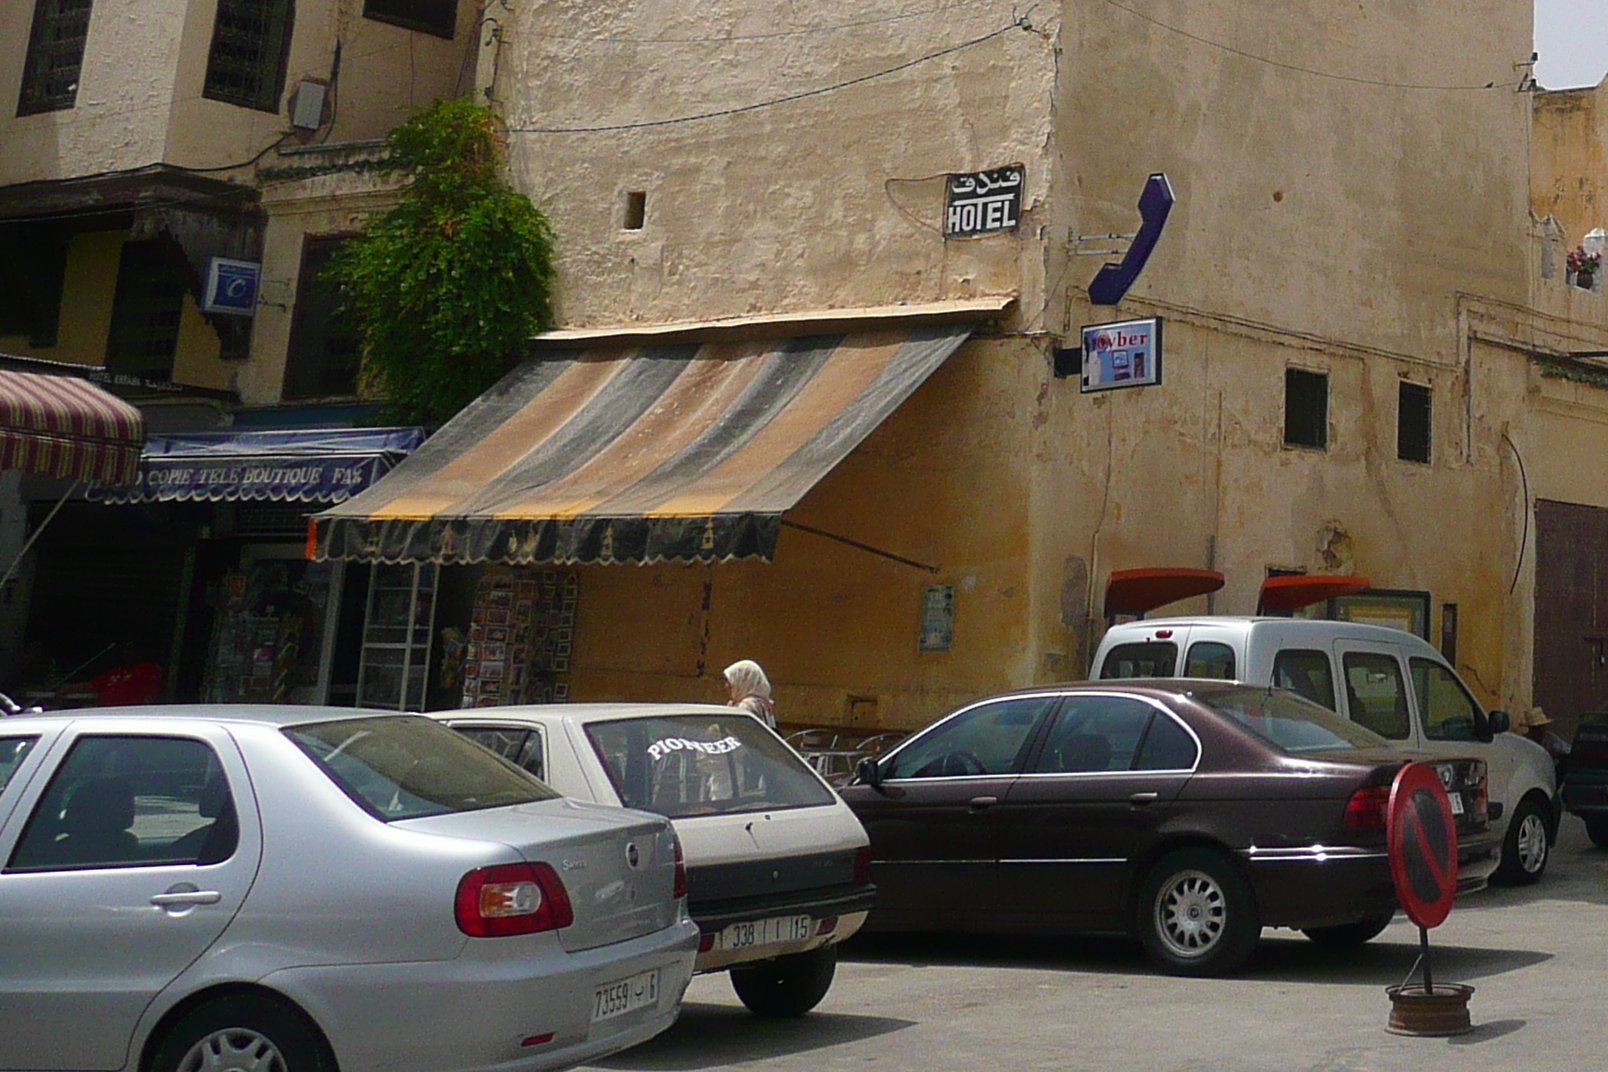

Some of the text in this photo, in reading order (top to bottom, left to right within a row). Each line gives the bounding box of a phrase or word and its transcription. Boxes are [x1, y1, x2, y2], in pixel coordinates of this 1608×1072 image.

[952, 171, 1020, 195] فندق
[946, 193, 1017, 234] HOTEL
[148, 468, 194, 485] COPIE
[242, 467, 323, 486] BOUTIQUE
[647, 736, 742, 761] PIONEER
[733, 923, 755, 948] 338
[795, 916, 809, 940] 15
[595, 982, 629, 1018] 73559
[650, 974, 656, 1000] 6
